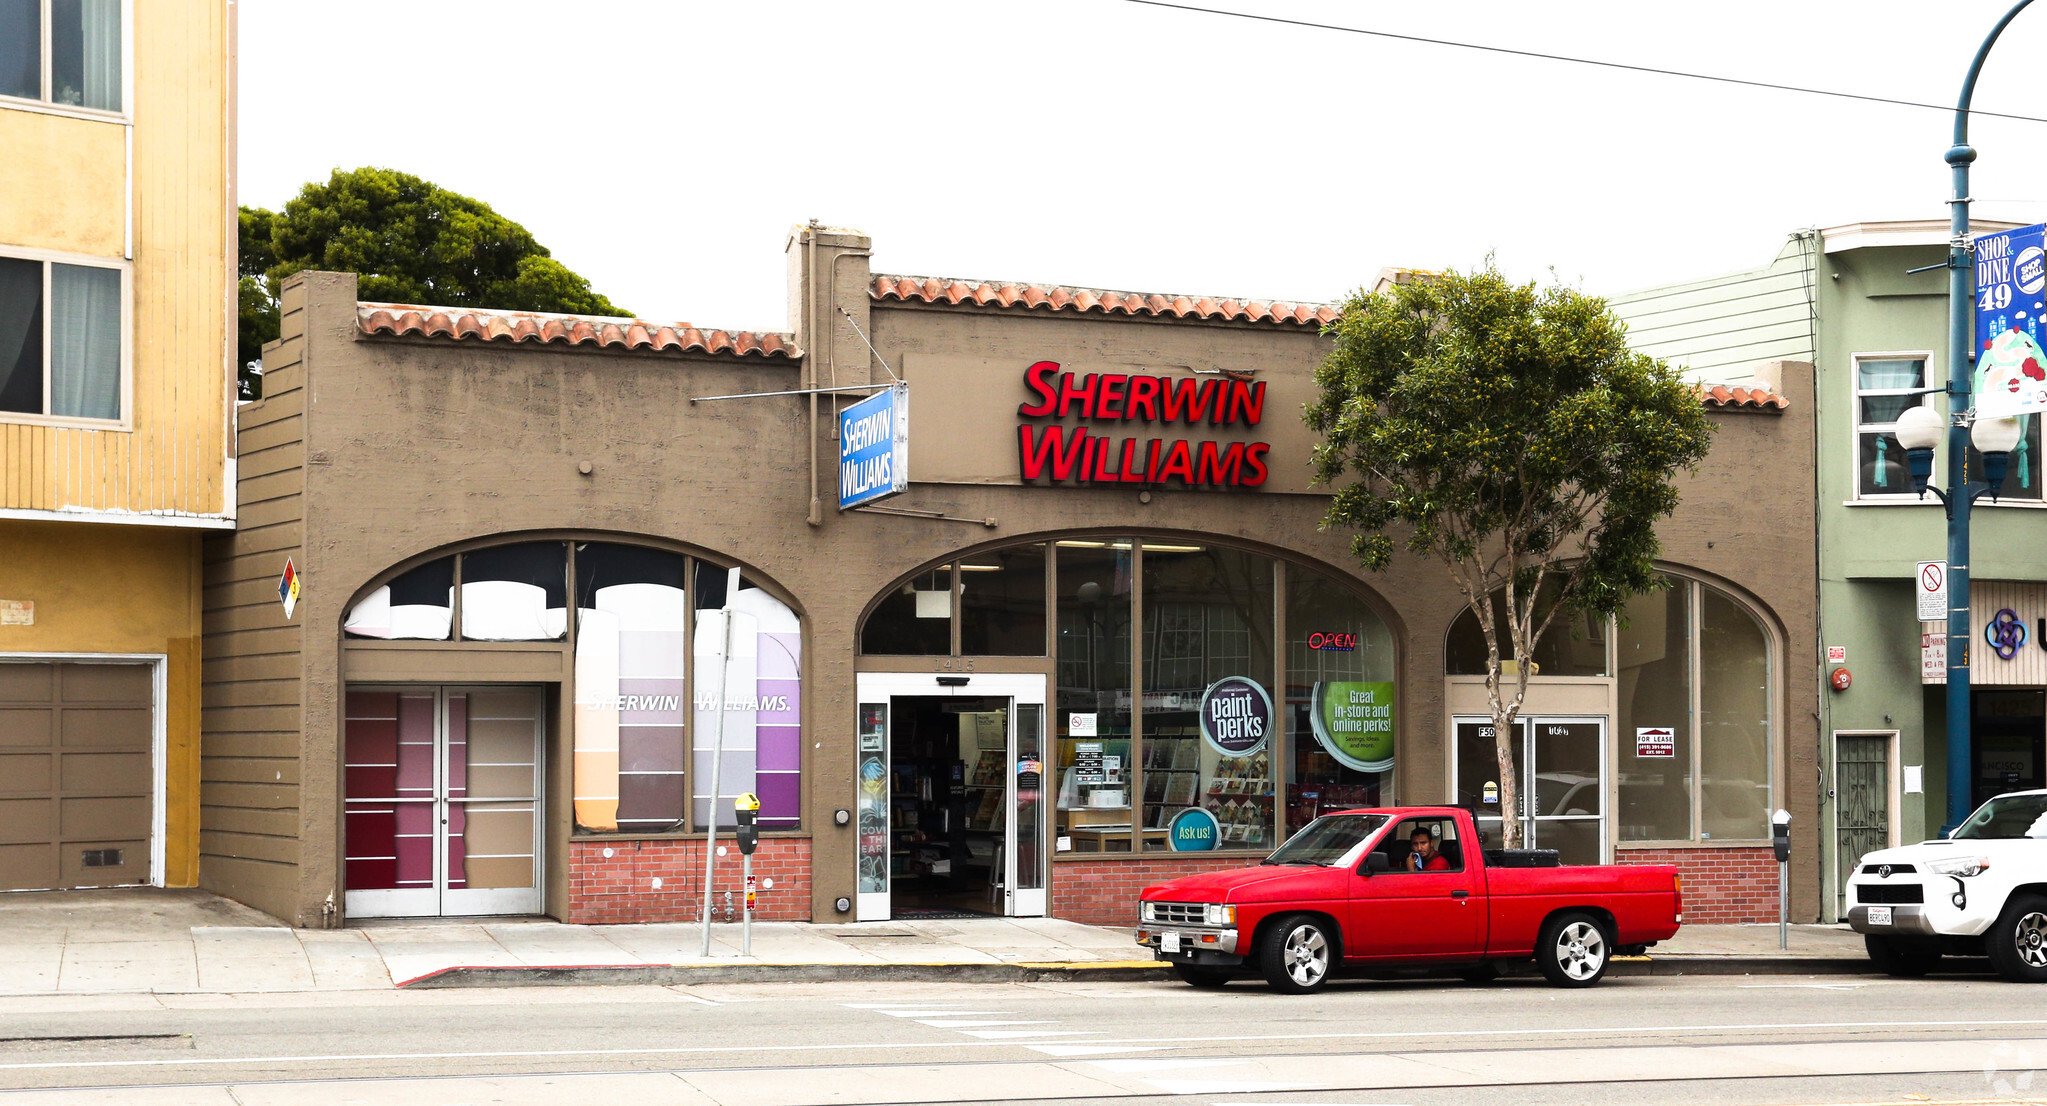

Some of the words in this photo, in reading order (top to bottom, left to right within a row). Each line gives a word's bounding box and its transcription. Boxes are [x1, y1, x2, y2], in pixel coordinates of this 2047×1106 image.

[1978, 235, 2010, 262] SHOP
[1978, 258, 2011, 288] DINE
[2021, 258, 2041, 276] SHOP
[2021, 265, 2045, 284] SMALL
[1978, 284, 2012, 312] 49
[1018, 361, 1267, 425] SHERWIN
[842, 407, 892, 457] SHERWIN
[1018, 424, 1271, 487] WILLIAMS
[1309, 632, 1357, 649] OPEN
[935, 658, 975, 671] 1415
[587, 691, 679, 711] SHERWIN
[696, 691, 792, 711] WLLIAMS.
[1350, 690, 1375, 704] Great
[1211, 692, 1254, 722] paint
[1334, 704, 1371, 718] in-store
[1372, 704, 1390, 718] and
[1333, 718, 1362, 732] online
[1363, 718, 1391, 734] perks!
[1179, 826, 1196, 840] Ask
[1196, 826, 1211, 839] us!
